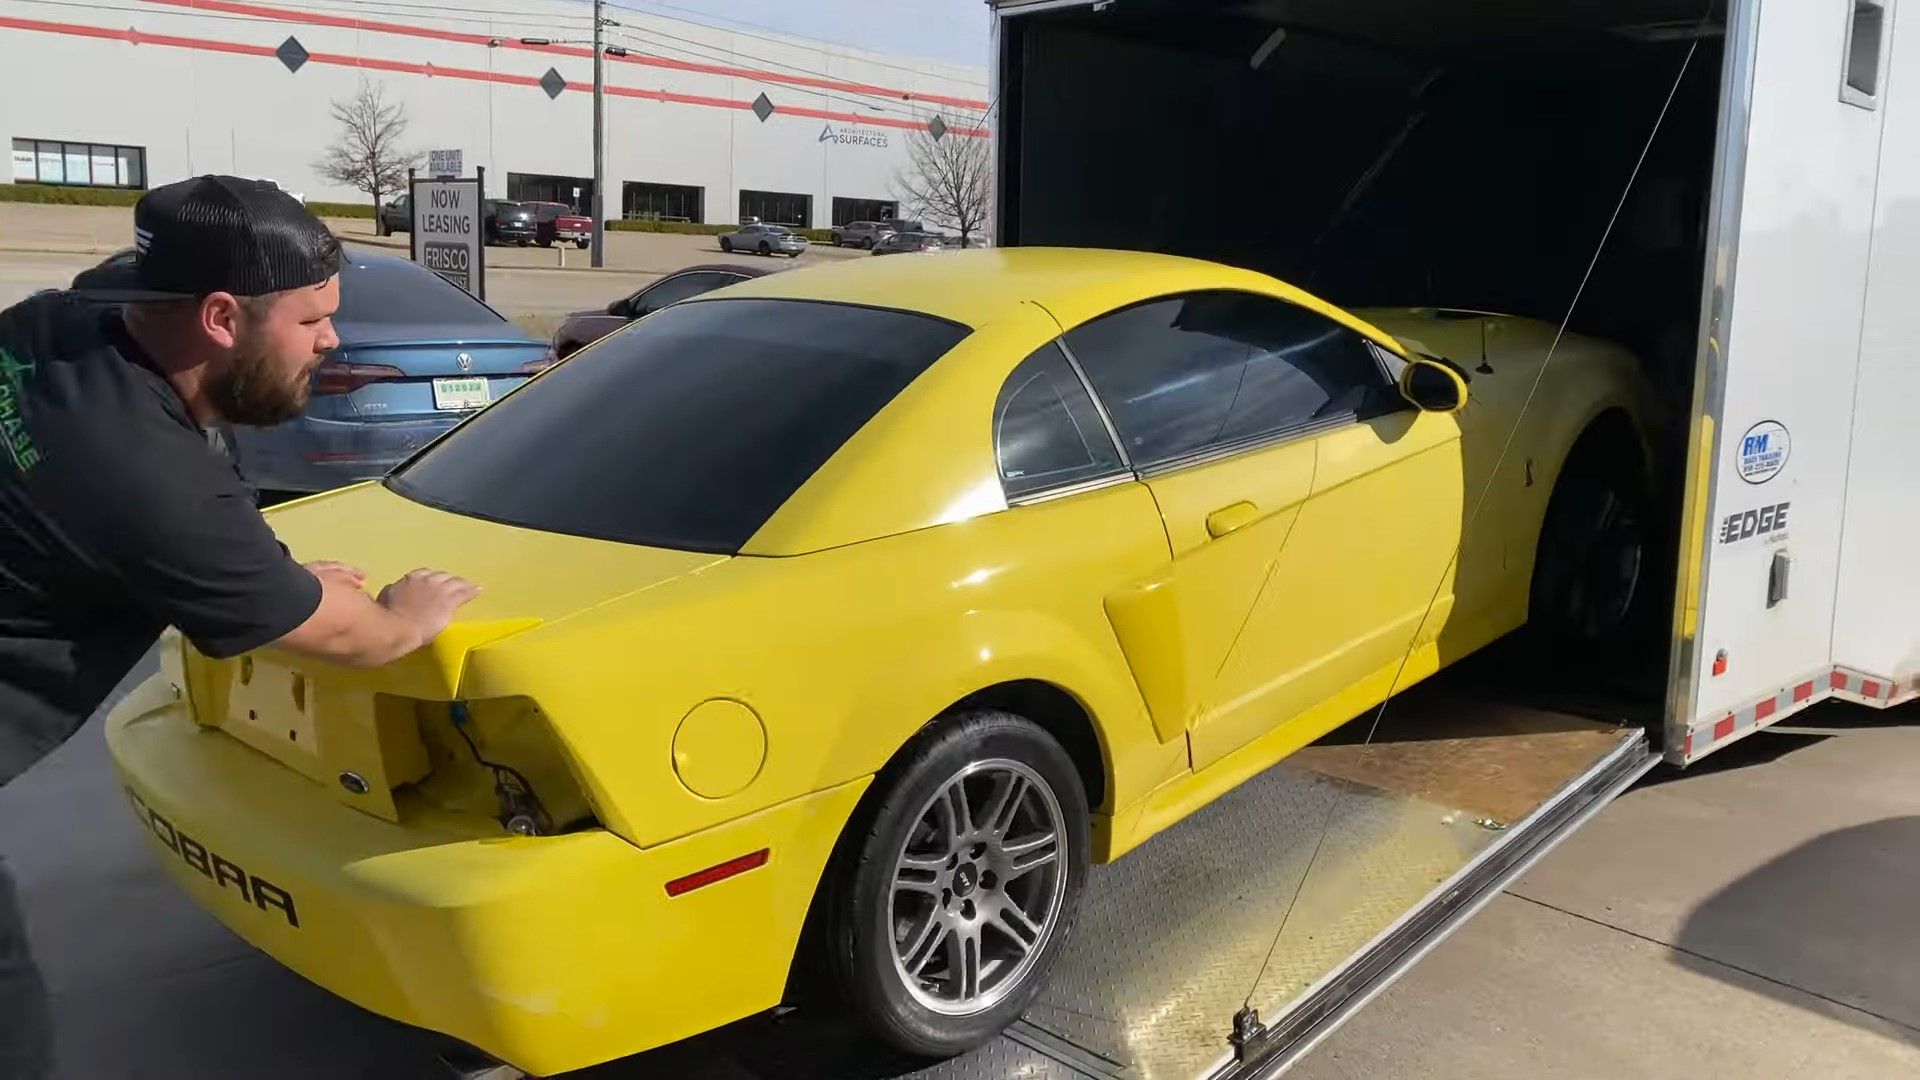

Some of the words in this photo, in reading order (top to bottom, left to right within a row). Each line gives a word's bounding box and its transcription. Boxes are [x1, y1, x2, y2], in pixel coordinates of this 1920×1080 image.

[839, 134, 888, 148] SURFACES
[431, 150, 444, 162] ONE
[445, 149, 460, 162] UNIT
[430, 161, 462, 173] AVAILABLE
[431, 190, 461, 209] NOW
[422, 214, 470, 234] LEASING
[425, 248, 469, 271] FRISCO
[1724, 501, 1791, 545] EDGE
[124, 784, 300, 930] COBRA
